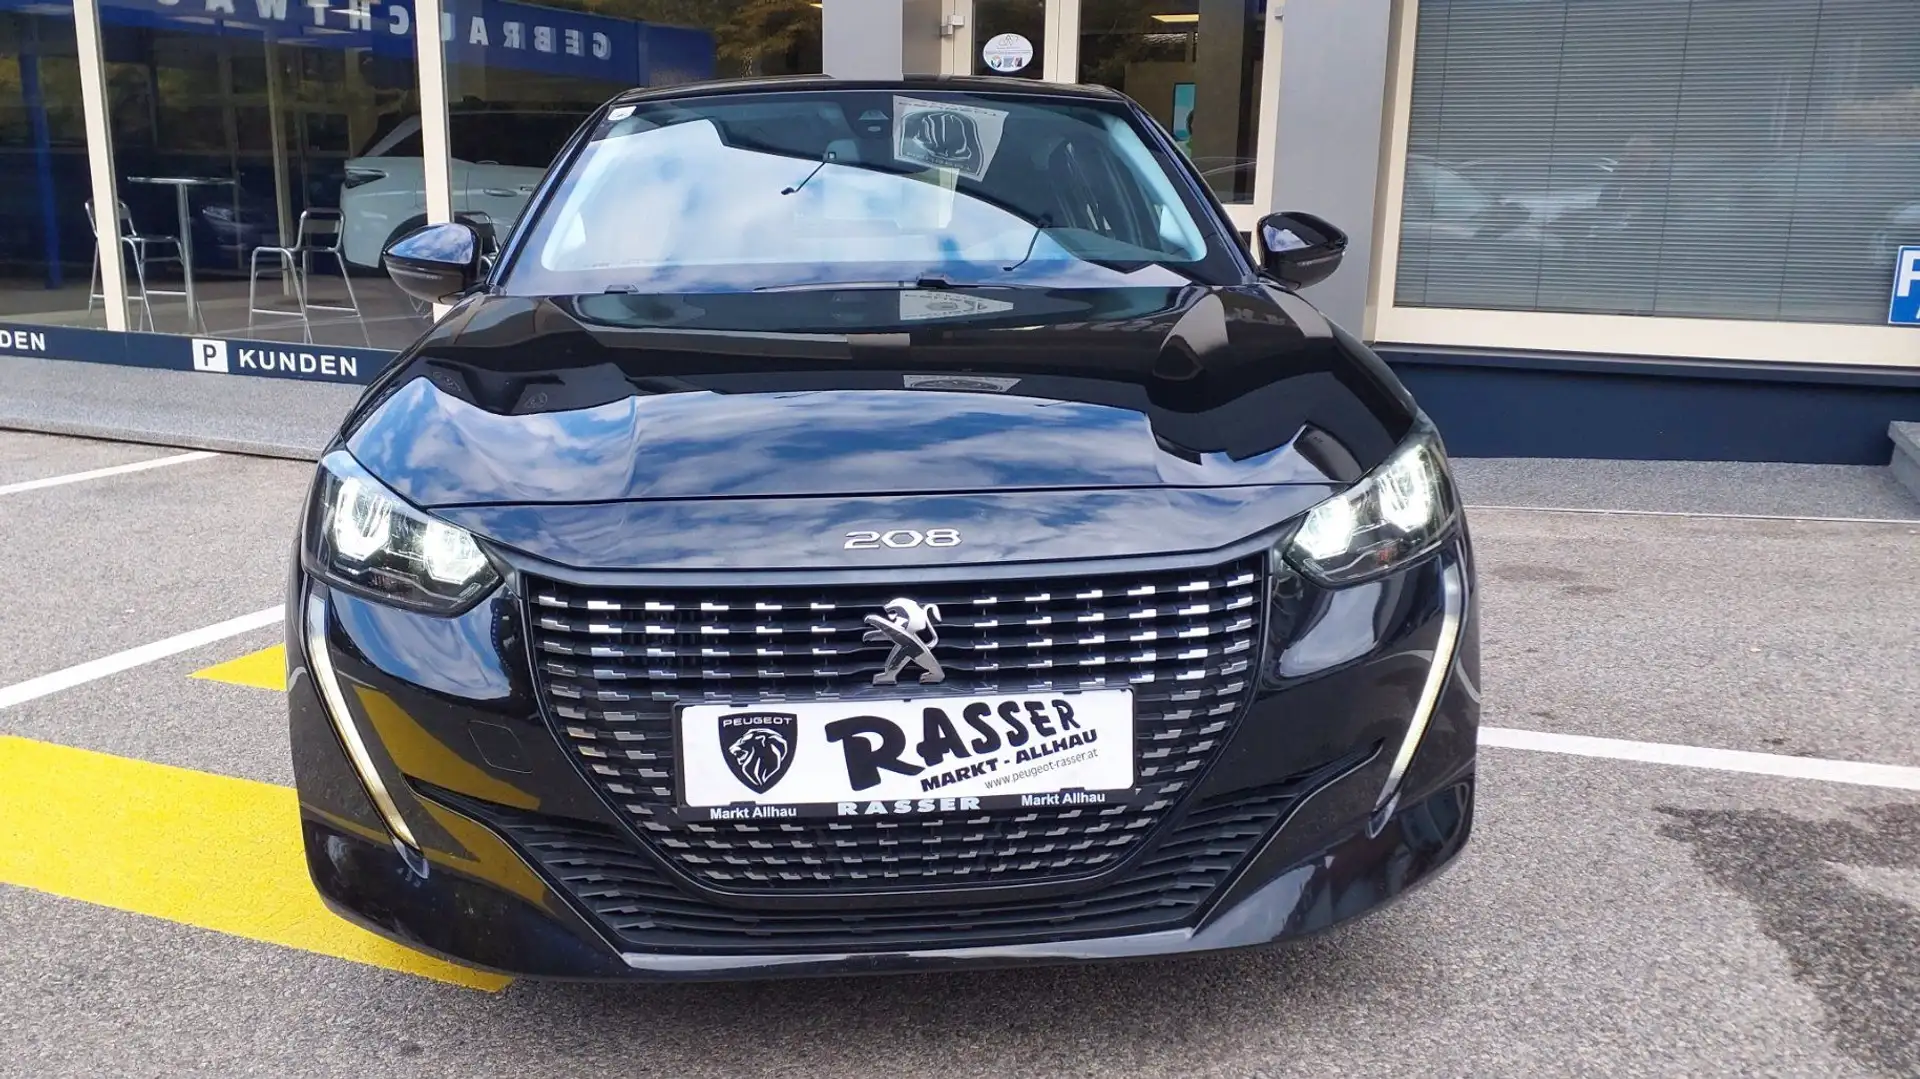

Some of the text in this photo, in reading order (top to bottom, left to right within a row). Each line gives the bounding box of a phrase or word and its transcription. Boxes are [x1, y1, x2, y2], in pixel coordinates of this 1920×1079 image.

[238, 348, 358, 377] KUNDEN
[843, 528, 962, 550] 208
[722, 715, 793, 728] PEUGEOT
[824, 699, 1081, 793] RASSER
[920, 757, 999, 792] MARKT
[1015, 729, 1098, 764] ALLHAU
[984, 747, 1099, 790] www.peugeot-rasser.at
[837, 797, 981, 816] RASSER
[1021, 791, 1106, 807] Markt Allhau
[710, 805, 797, 820] Markt Allhau
